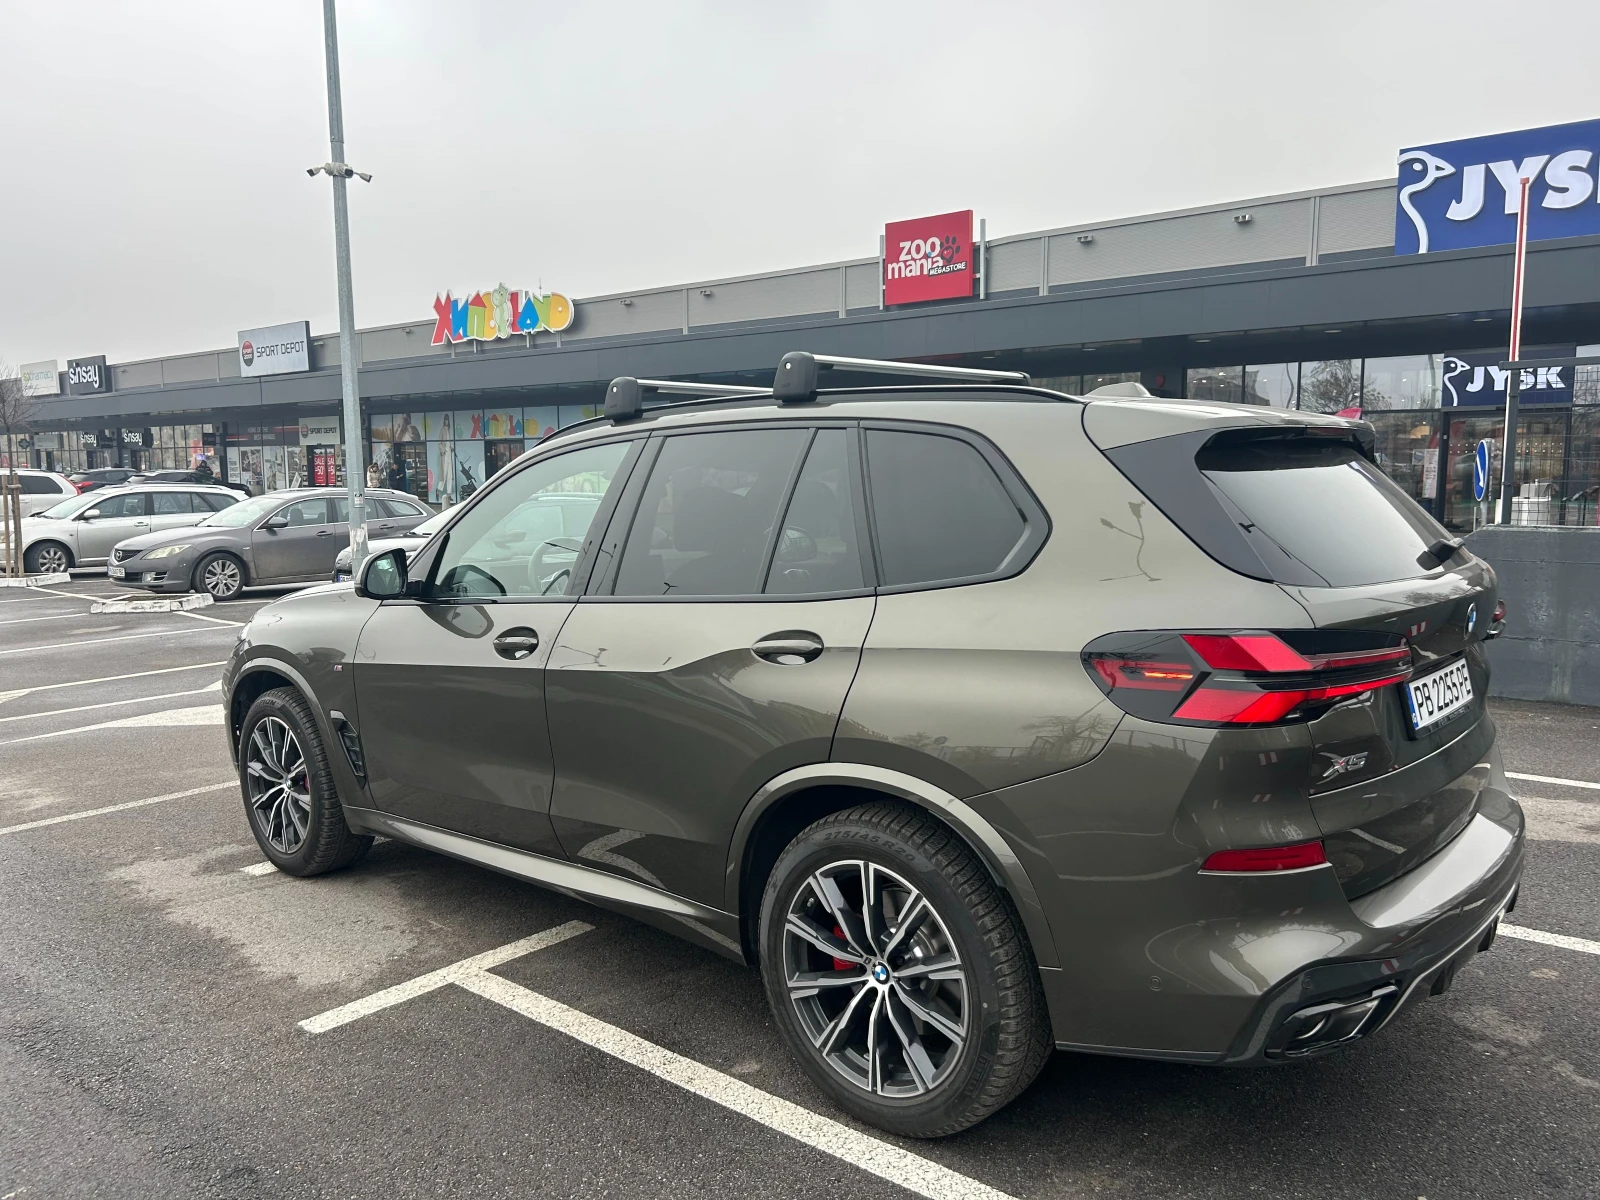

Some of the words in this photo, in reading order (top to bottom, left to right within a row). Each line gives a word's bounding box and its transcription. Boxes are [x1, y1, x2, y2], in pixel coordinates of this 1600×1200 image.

[1445, 150, 1600, 221] JYS
[887, 256, 943, 280] mania
[929, 261, 966, 276] MEGASTORE
[256, 344, 279, 358] SPORT
[280, 341, 305, 354] DEPOT
[69, 362, 100, 388] sinsay
[80, 431, 97, 447] sinsay
[123, 430, 142, 446] sinsay
[314, 457, 325, 465] SALE
[1413, 682, 1434, 721] PB
[1431, 669, 1459, 712] 2255
[1317, 751, 1369, 785] X5
[823, 830, 881, 843] 275/45
